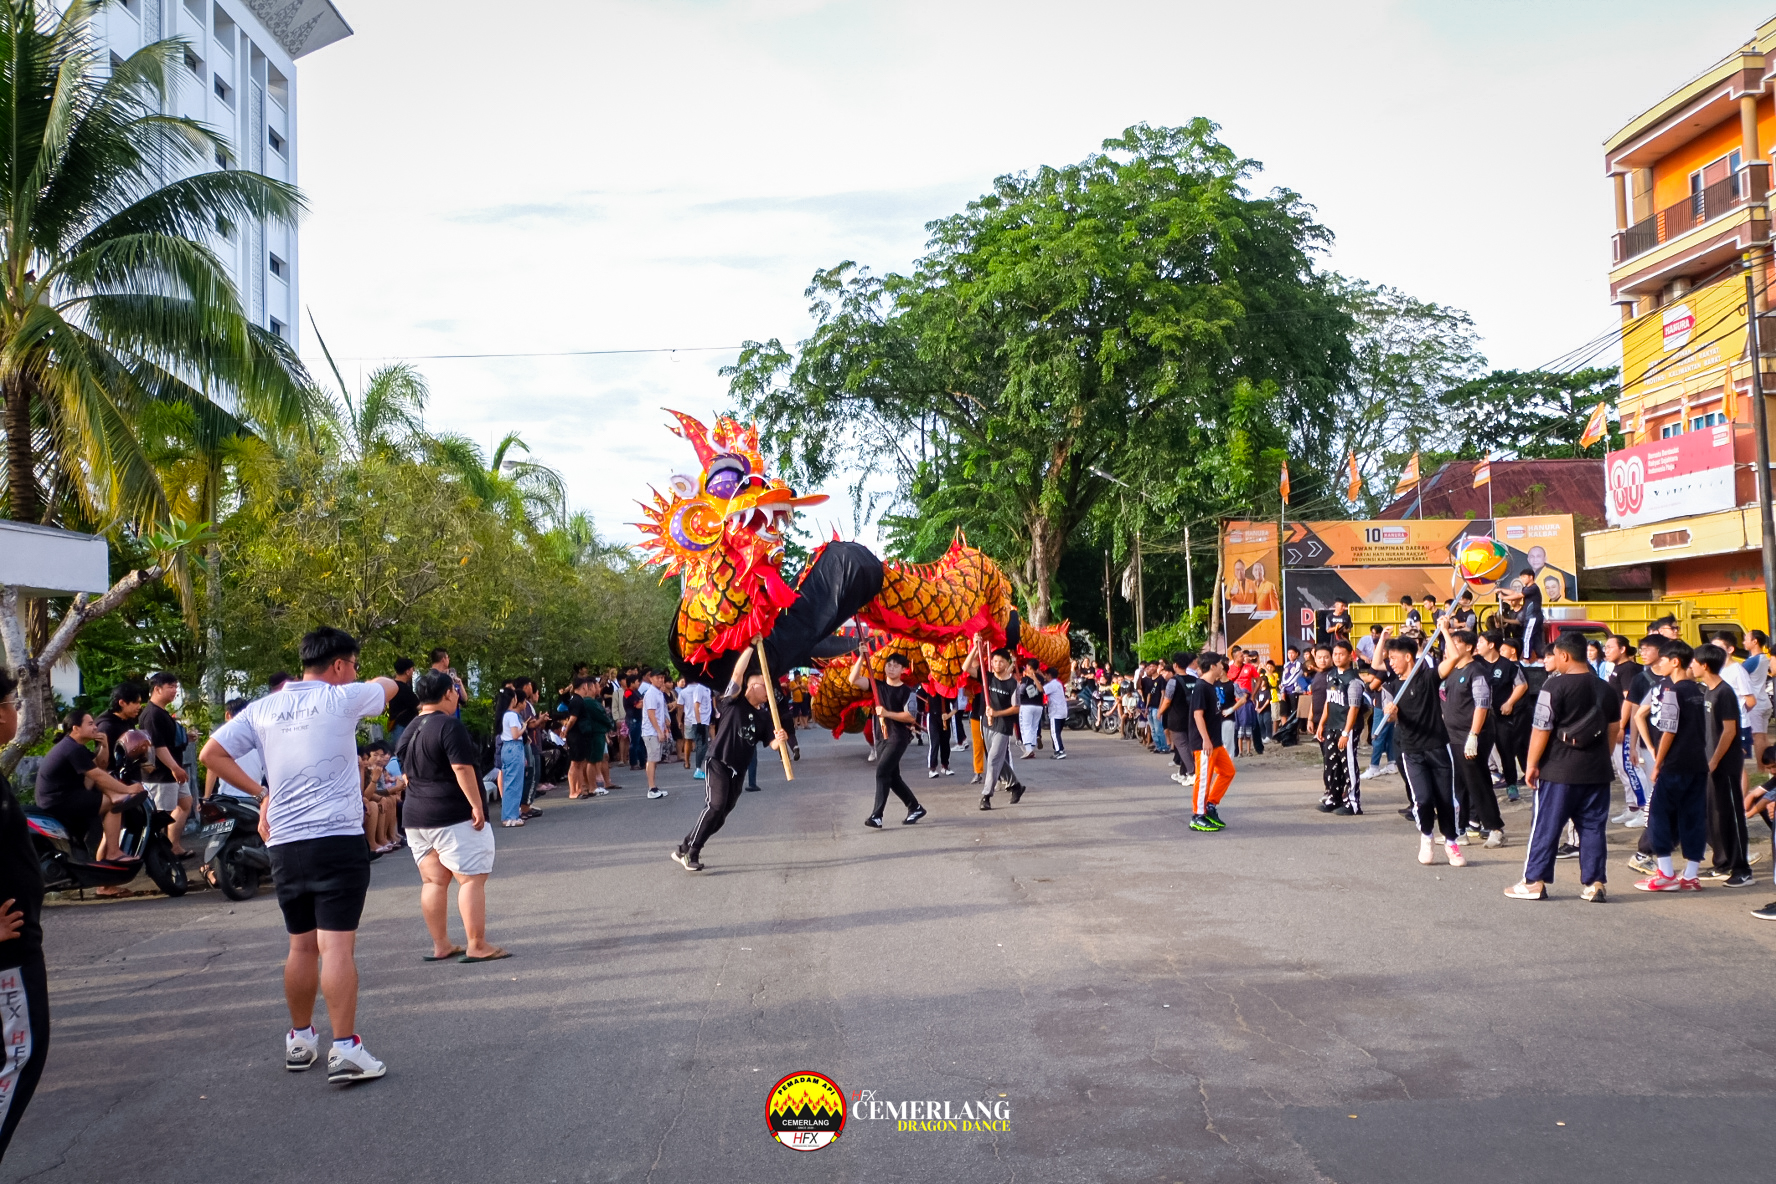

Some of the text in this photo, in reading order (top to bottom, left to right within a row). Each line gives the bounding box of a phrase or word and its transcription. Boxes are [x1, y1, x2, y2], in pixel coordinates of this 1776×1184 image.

[1665, 318, 1691, 336] HANURA
[1611, 455, 1645, 517] 80
[1365, 528, 1381, 543] 10
[1528, 524, 1560, 532] HANURA
[1528, 530, 1558, 538] KALBAR
[271, 706, 320, 721] PANITIA
